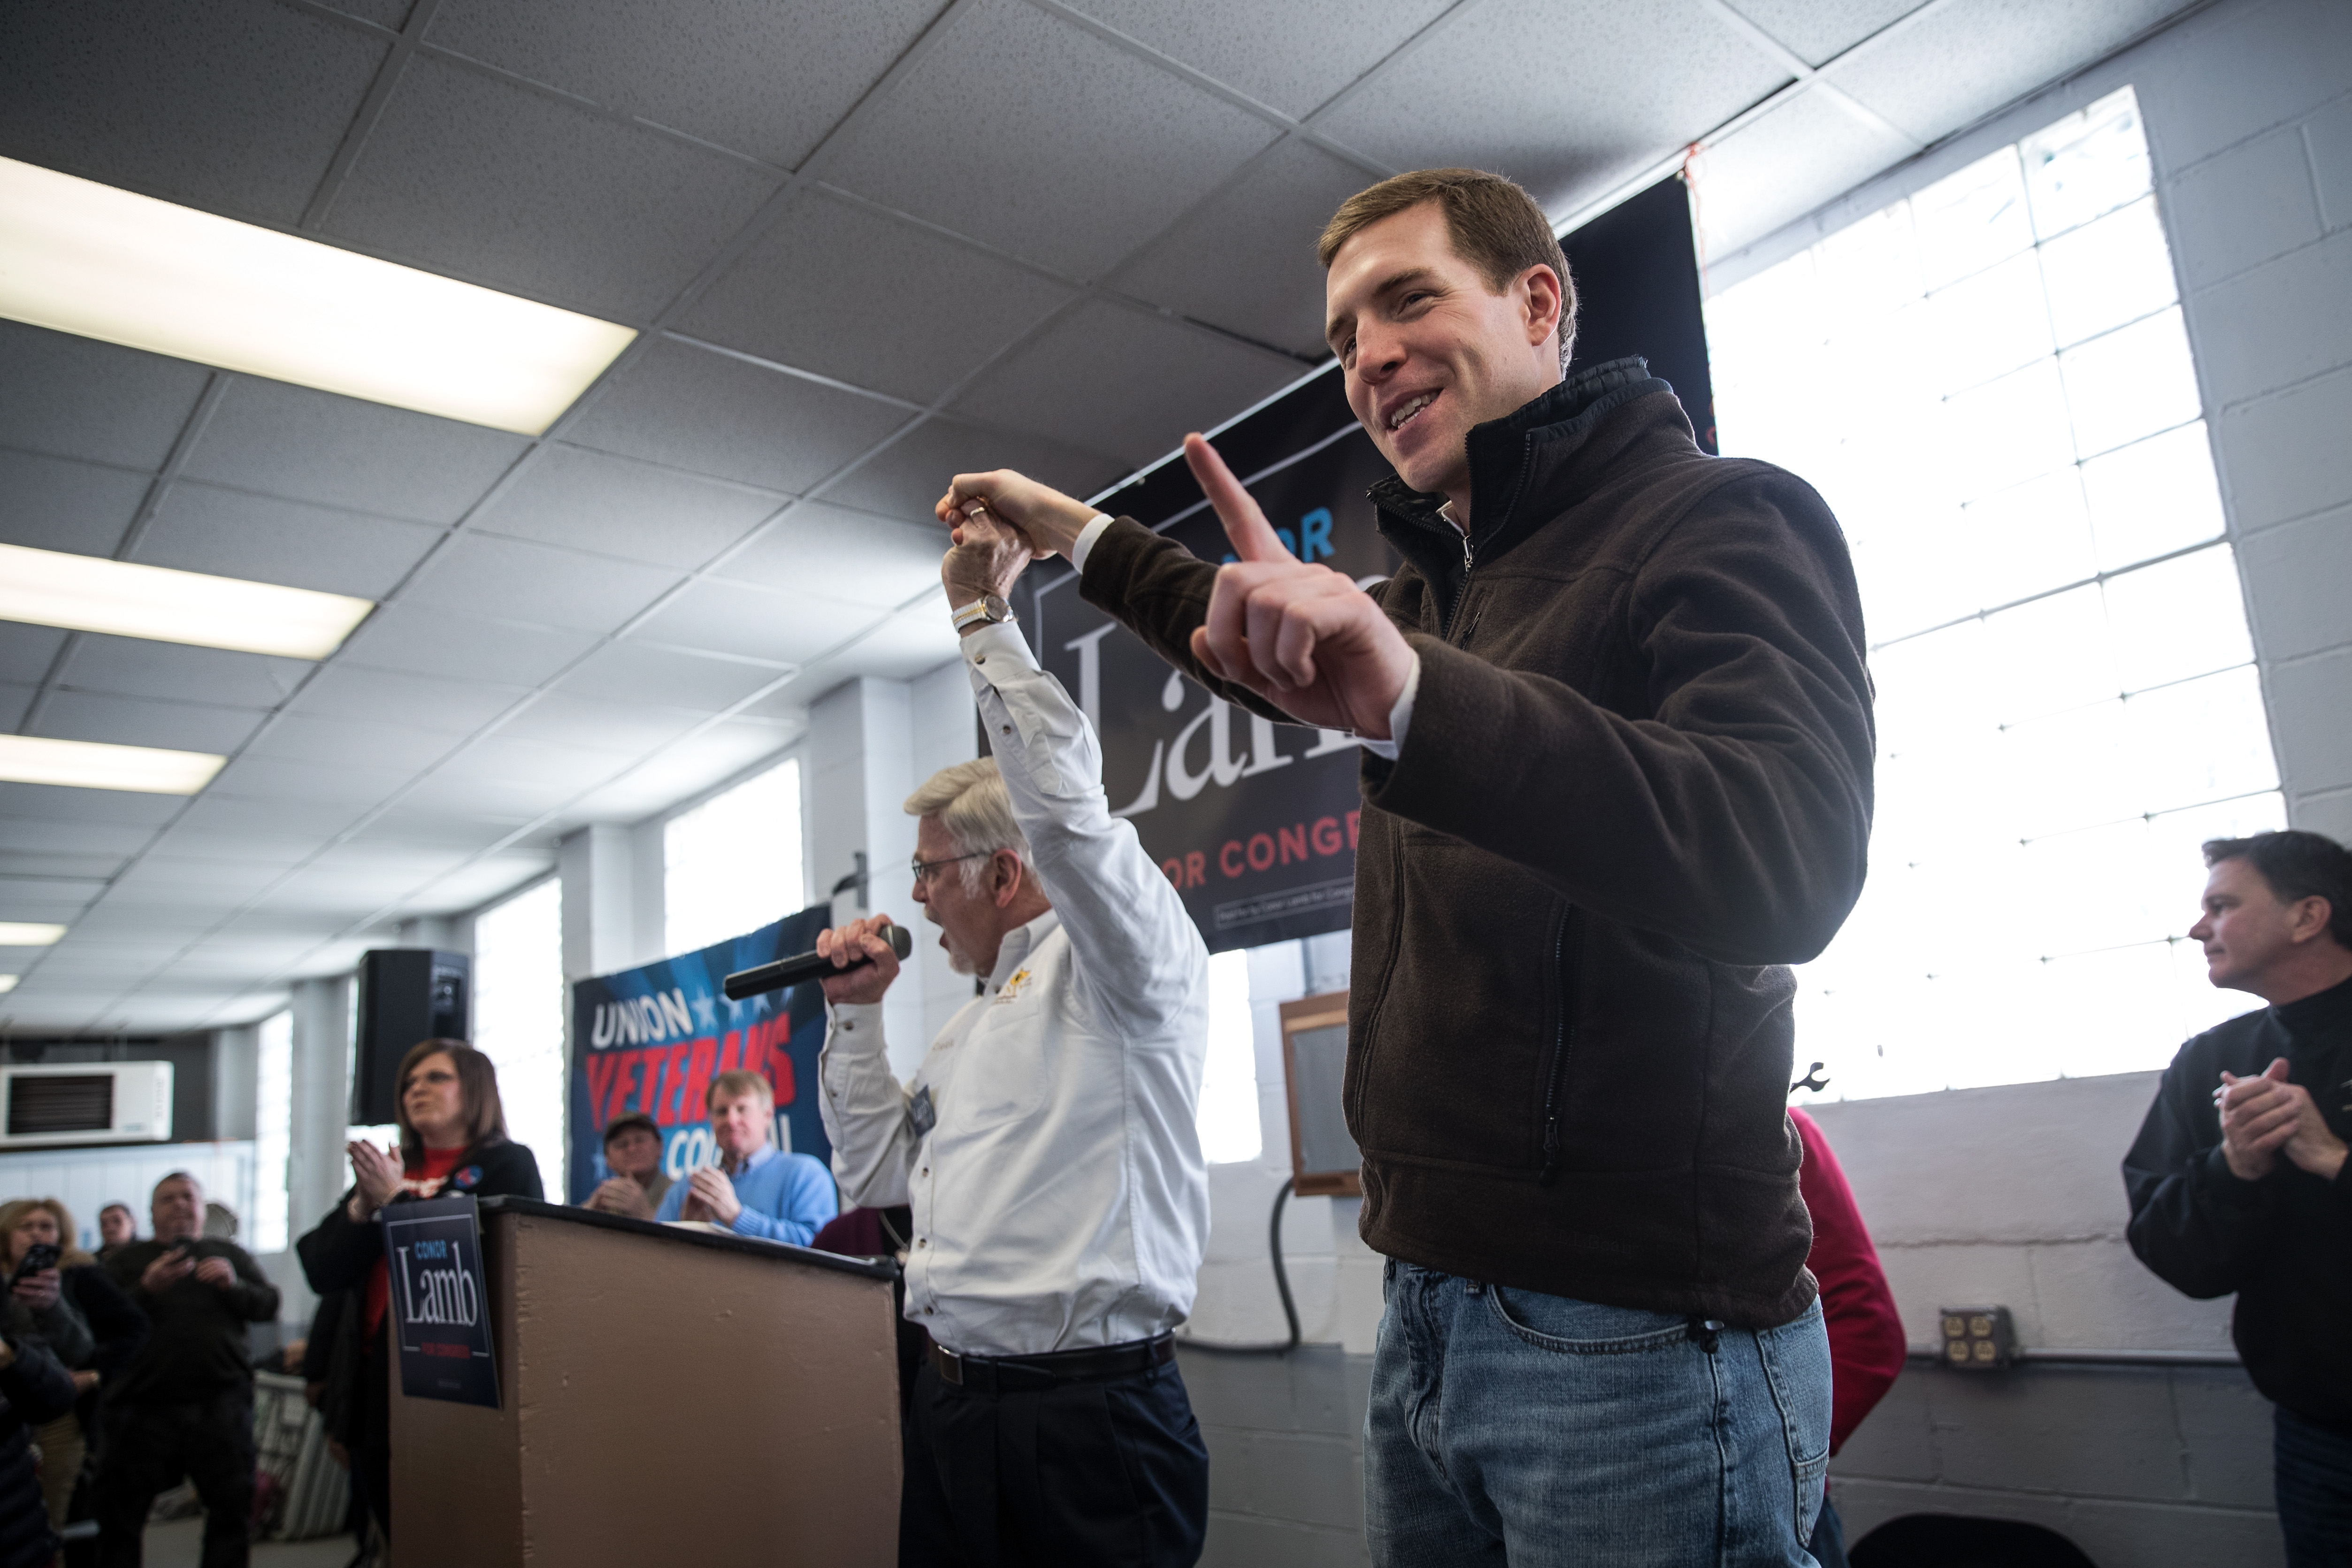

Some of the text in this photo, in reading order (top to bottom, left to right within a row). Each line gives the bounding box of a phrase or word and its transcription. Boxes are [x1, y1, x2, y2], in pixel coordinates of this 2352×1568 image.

[591, 987, 693, 1049] UNION
[414, 1239, 447, 1261] CONOR
[396, 1240, 478, 1327] Lamb
